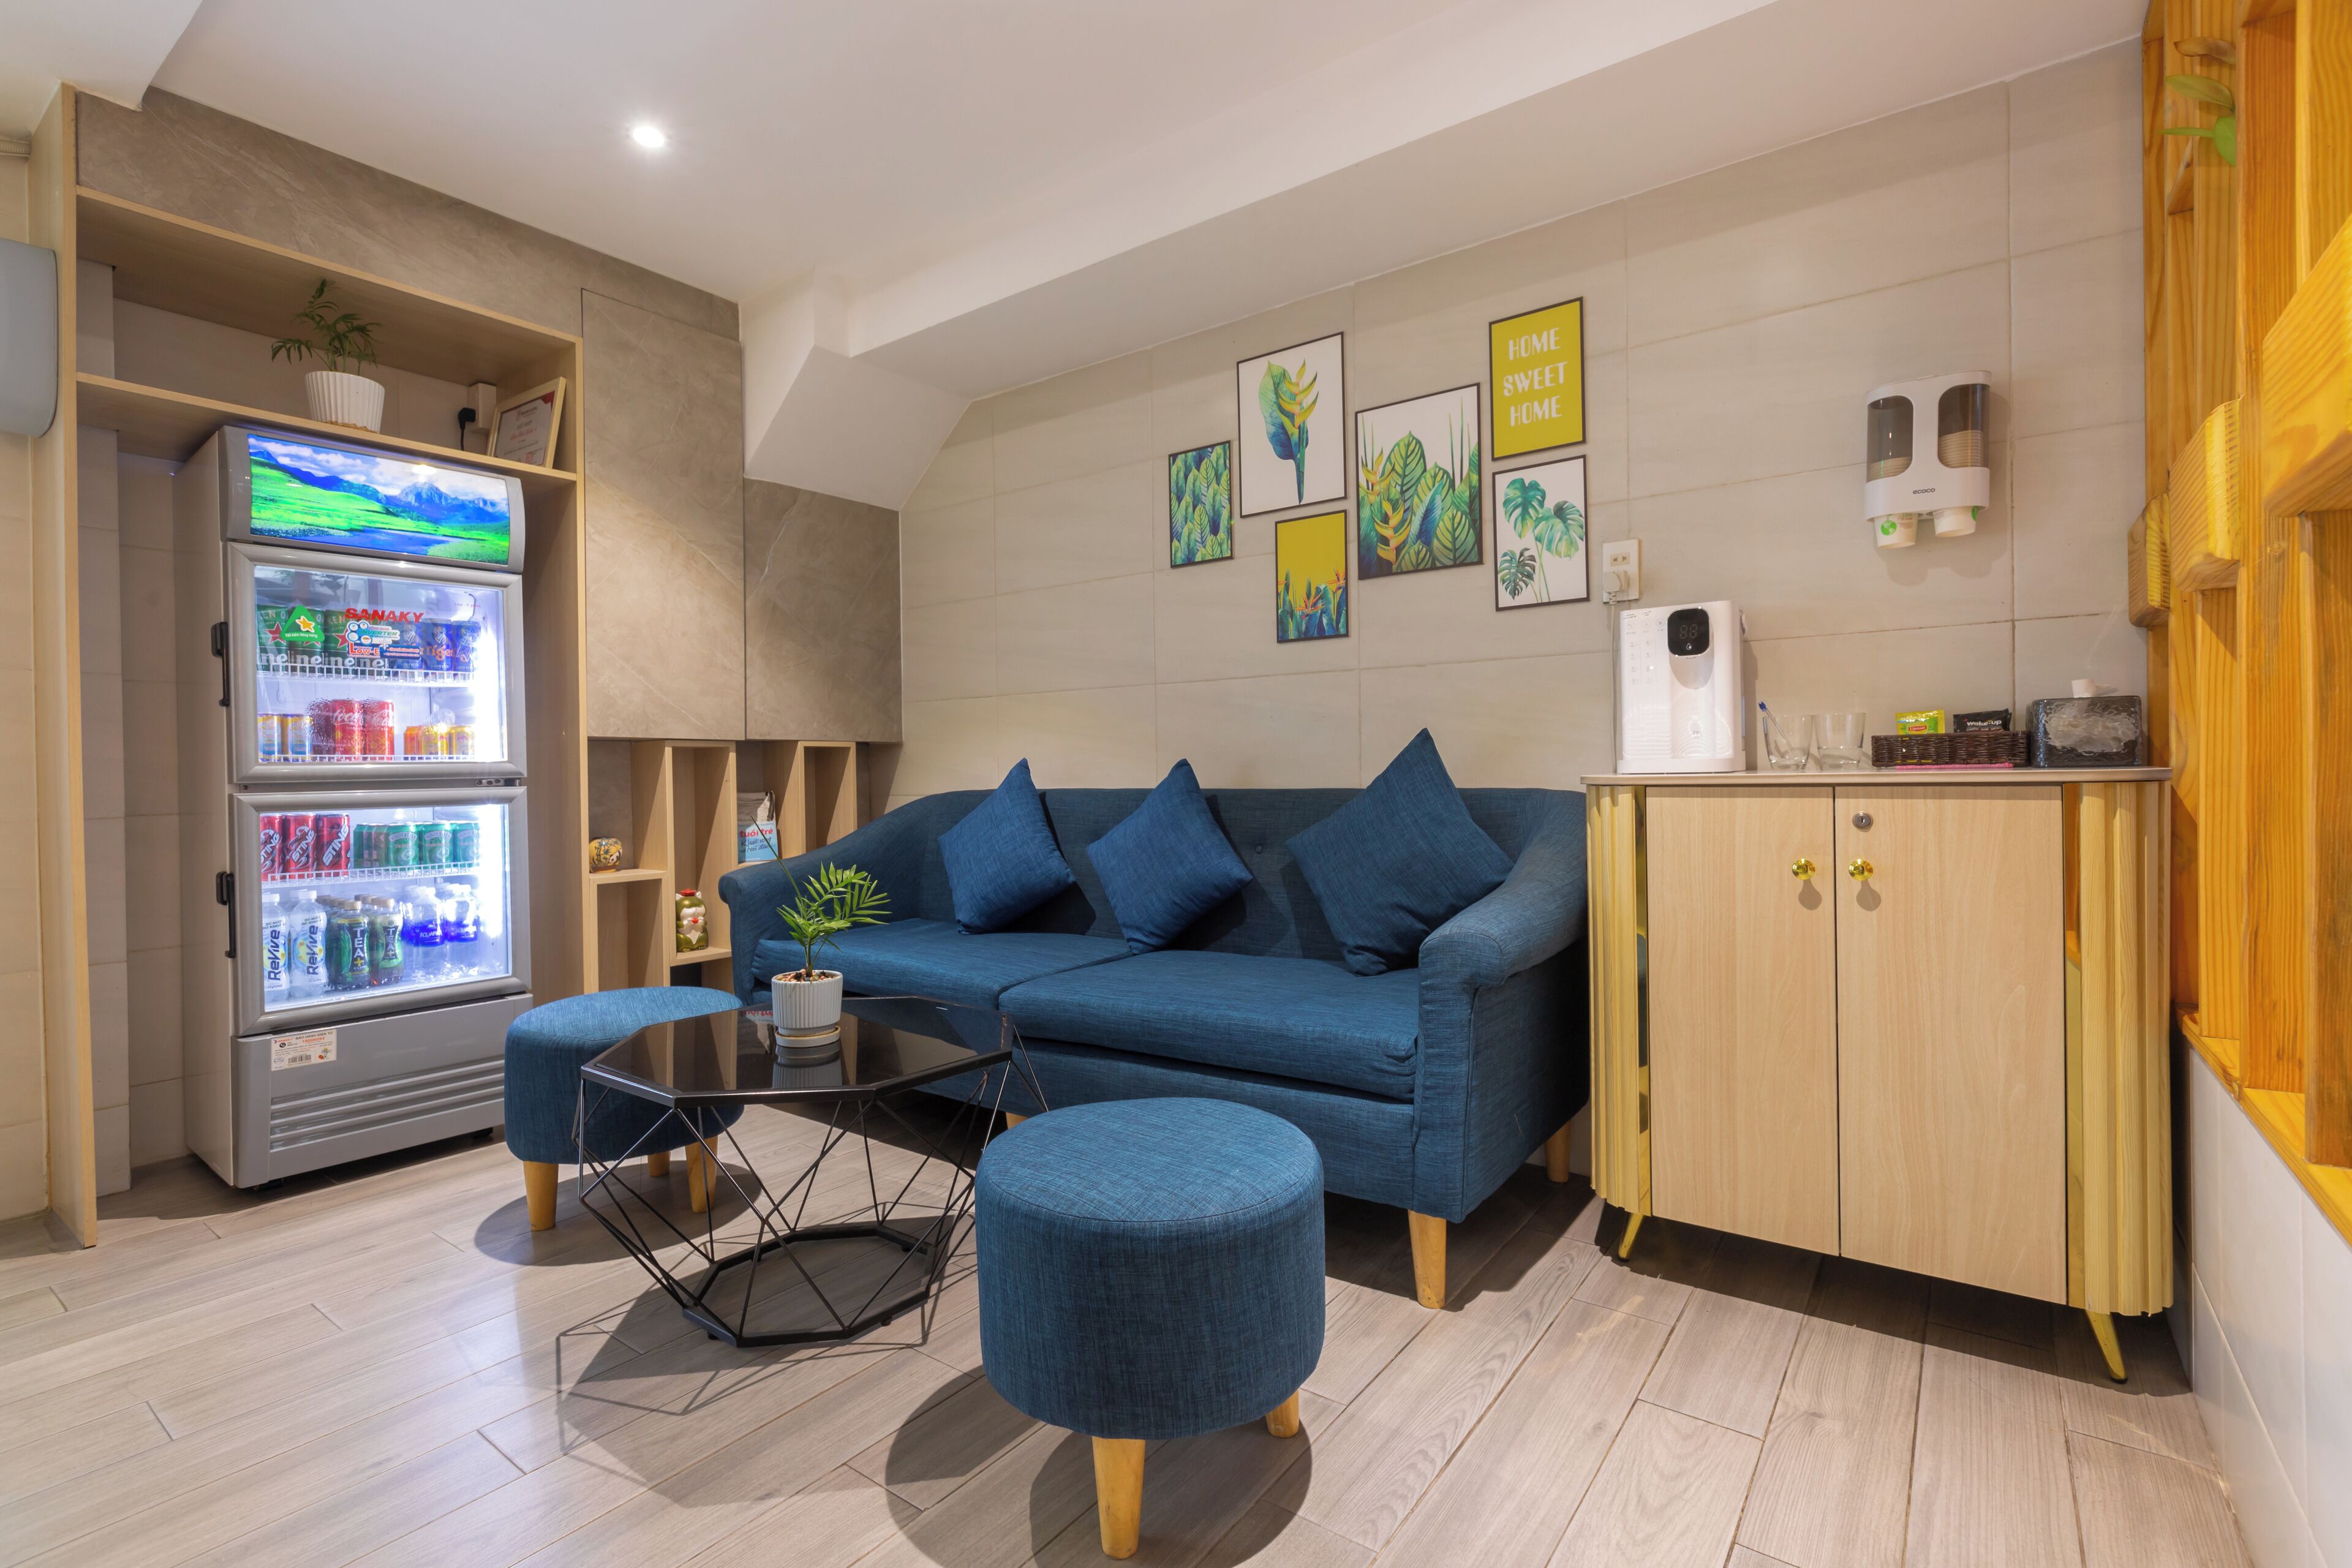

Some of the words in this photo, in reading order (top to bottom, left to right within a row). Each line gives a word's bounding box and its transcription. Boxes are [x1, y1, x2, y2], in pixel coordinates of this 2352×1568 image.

[1509, 327, 1560, 360] HOME
[1503, 361, 1568, 397] SWEET
[1510, 395, 1562, 427] HOME
[344, 608, 424, 623] SANAKY
[292, 829, 315, 862] STING
[323, 823, 349, 867] STING
